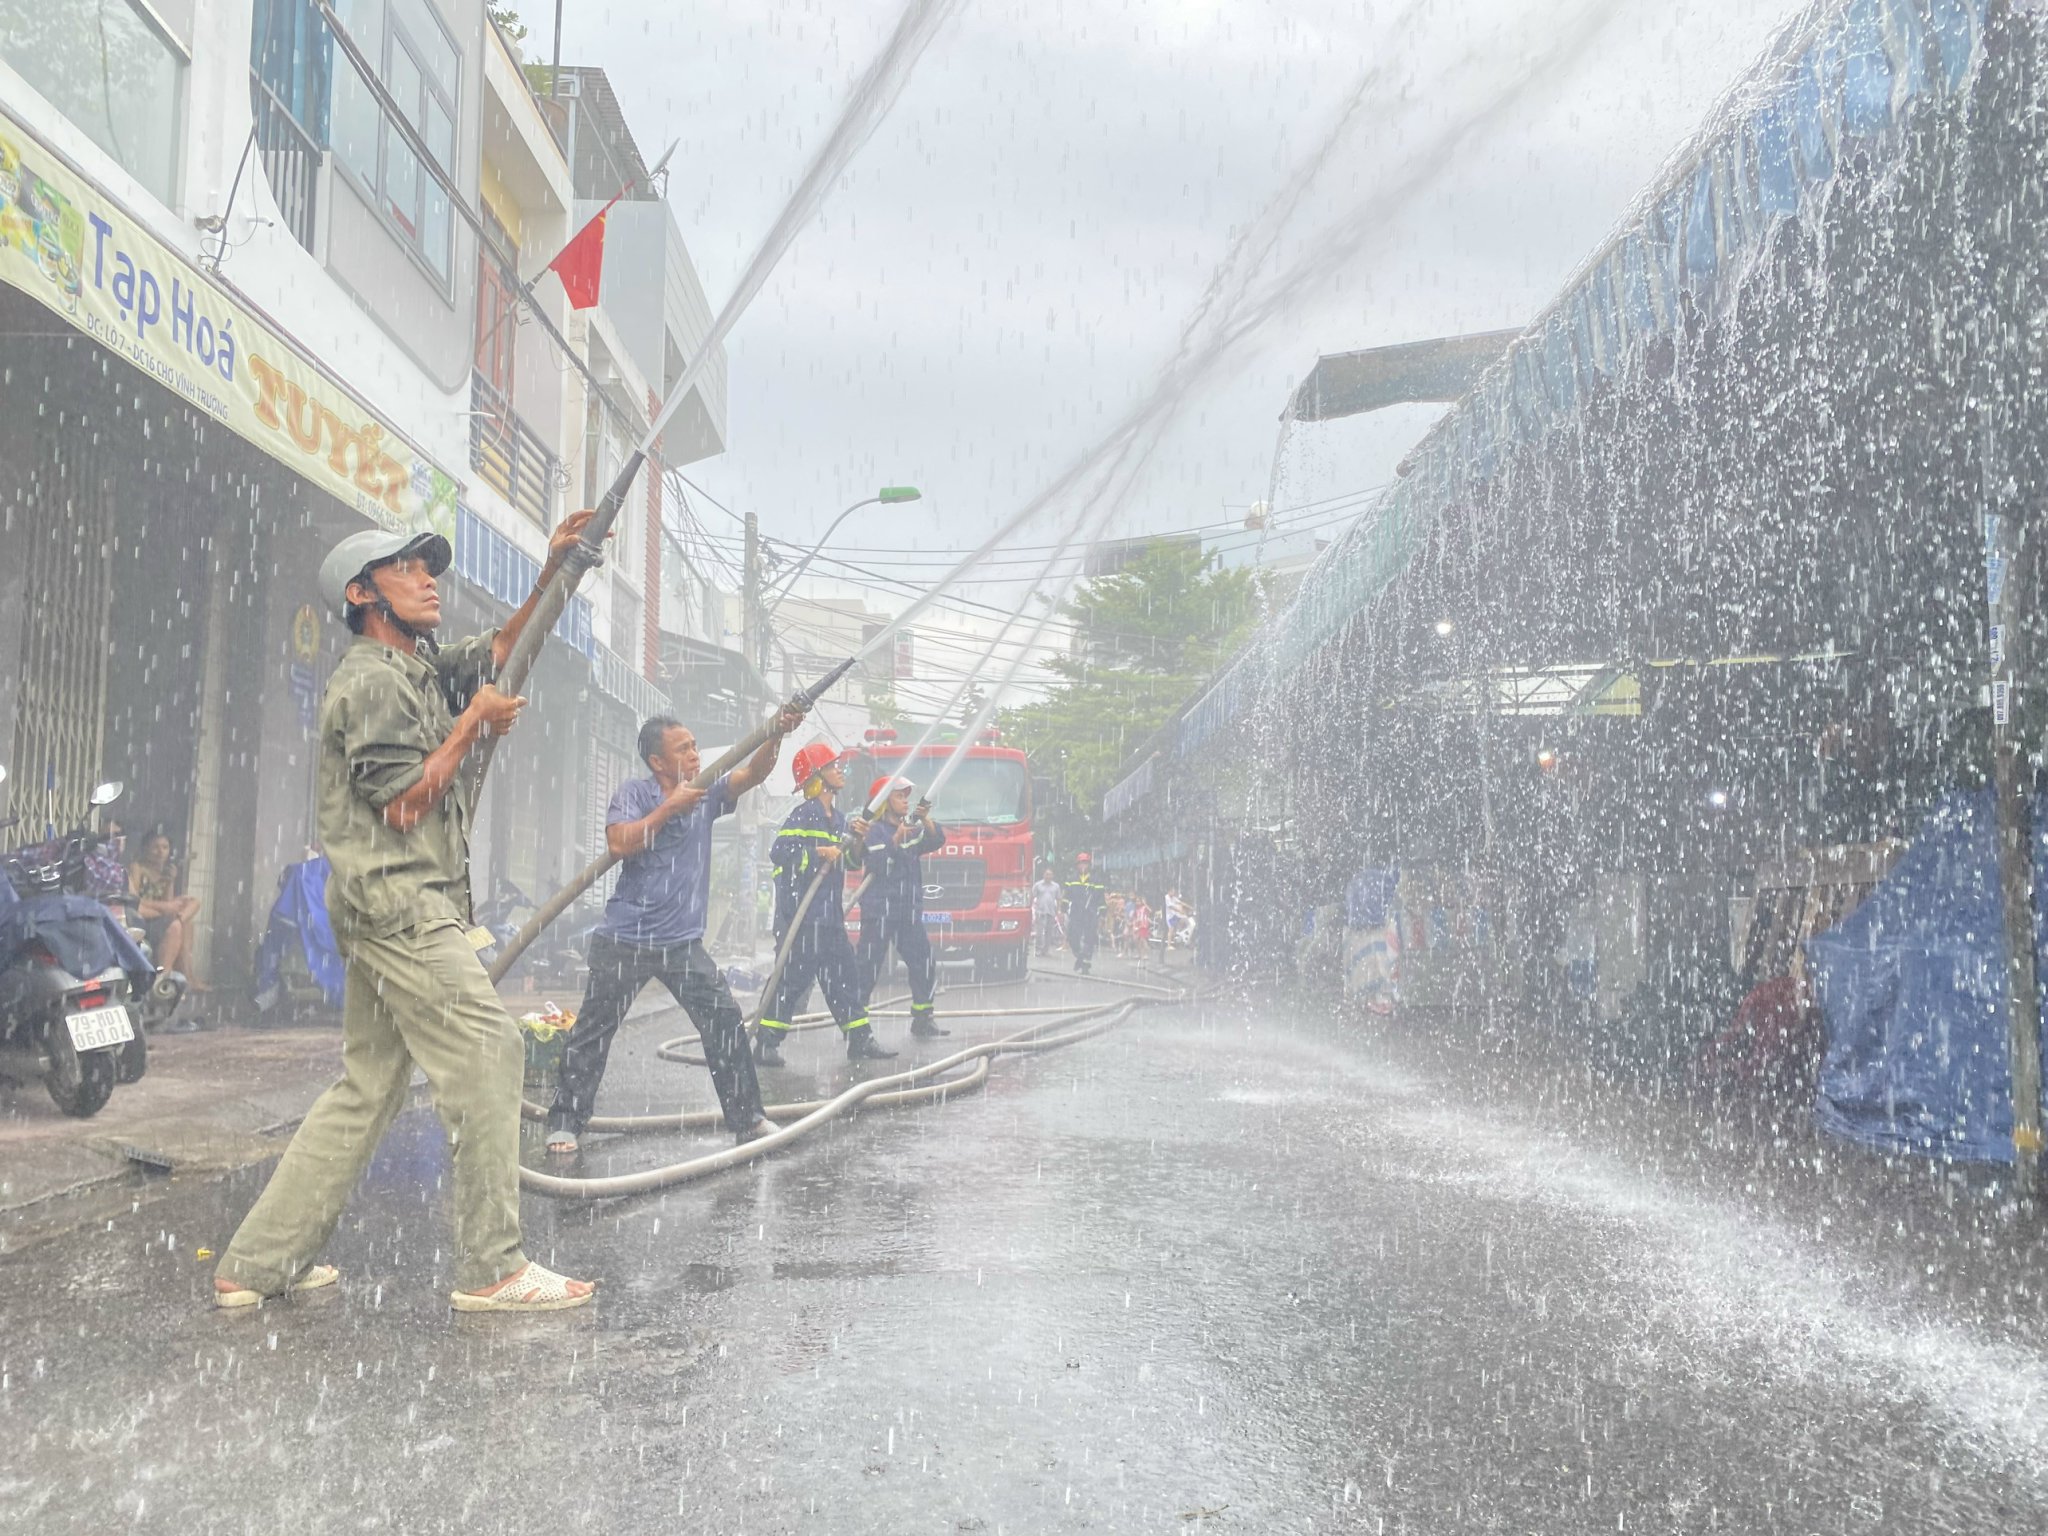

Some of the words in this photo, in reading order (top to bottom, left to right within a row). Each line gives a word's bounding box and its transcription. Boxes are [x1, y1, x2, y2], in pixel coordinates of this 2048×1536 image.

[89, 211, 160, 340] Tạp
[172, 276, 235, 383] Hoá
[119, 334, 126, 350] 7
[71, 1009, 123, 1033] 79-MD1
[75, 1024, 130, 1049] 060.04
